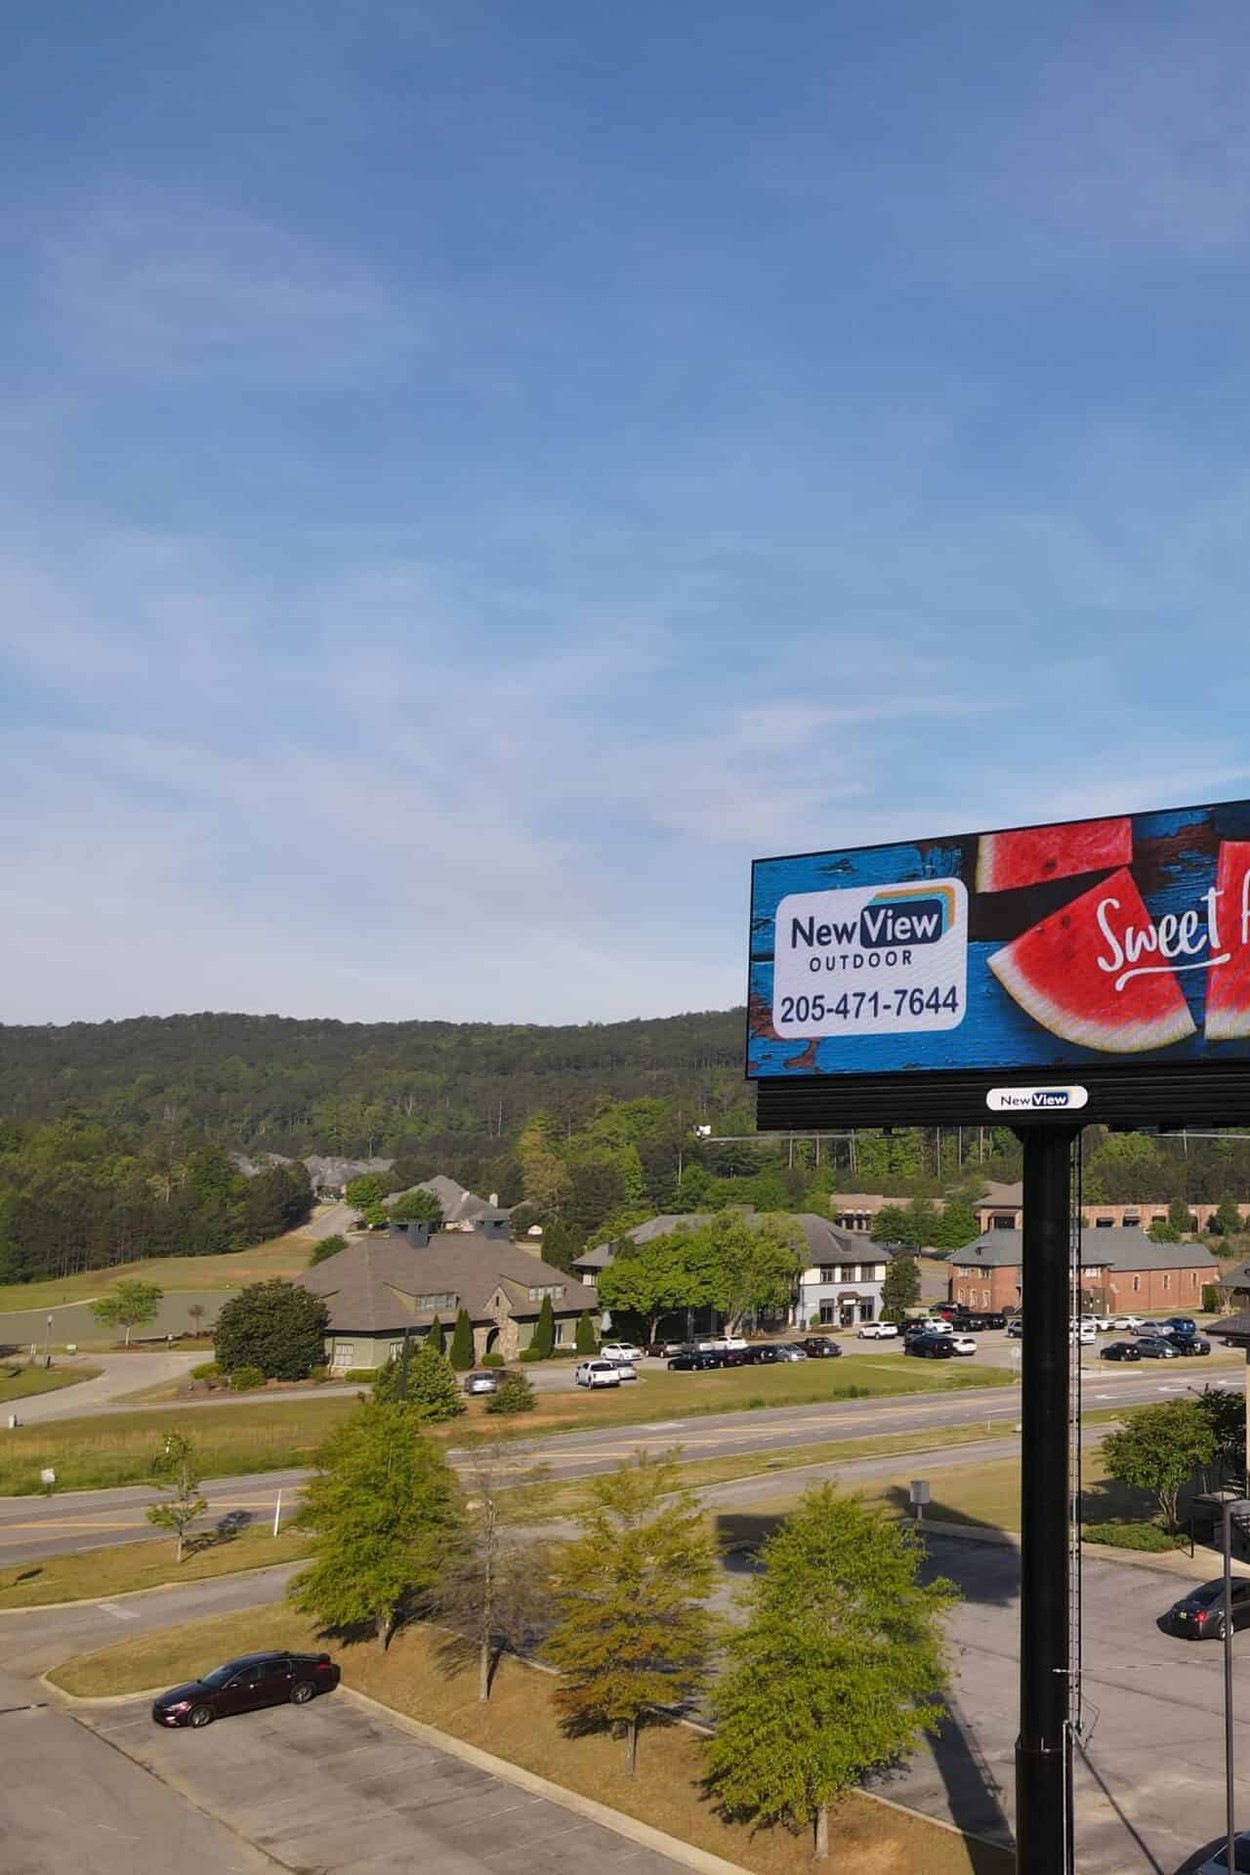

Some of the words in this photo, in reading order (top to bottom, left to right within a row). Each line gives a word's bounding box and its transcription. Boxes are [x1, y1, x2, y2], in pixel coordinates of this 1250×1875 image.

[1096, 886, 1225, 973] Sweet
[809, 950, 913, 972] OUTDOOR
[780, 985, 960, 1023] 205-471-7644
